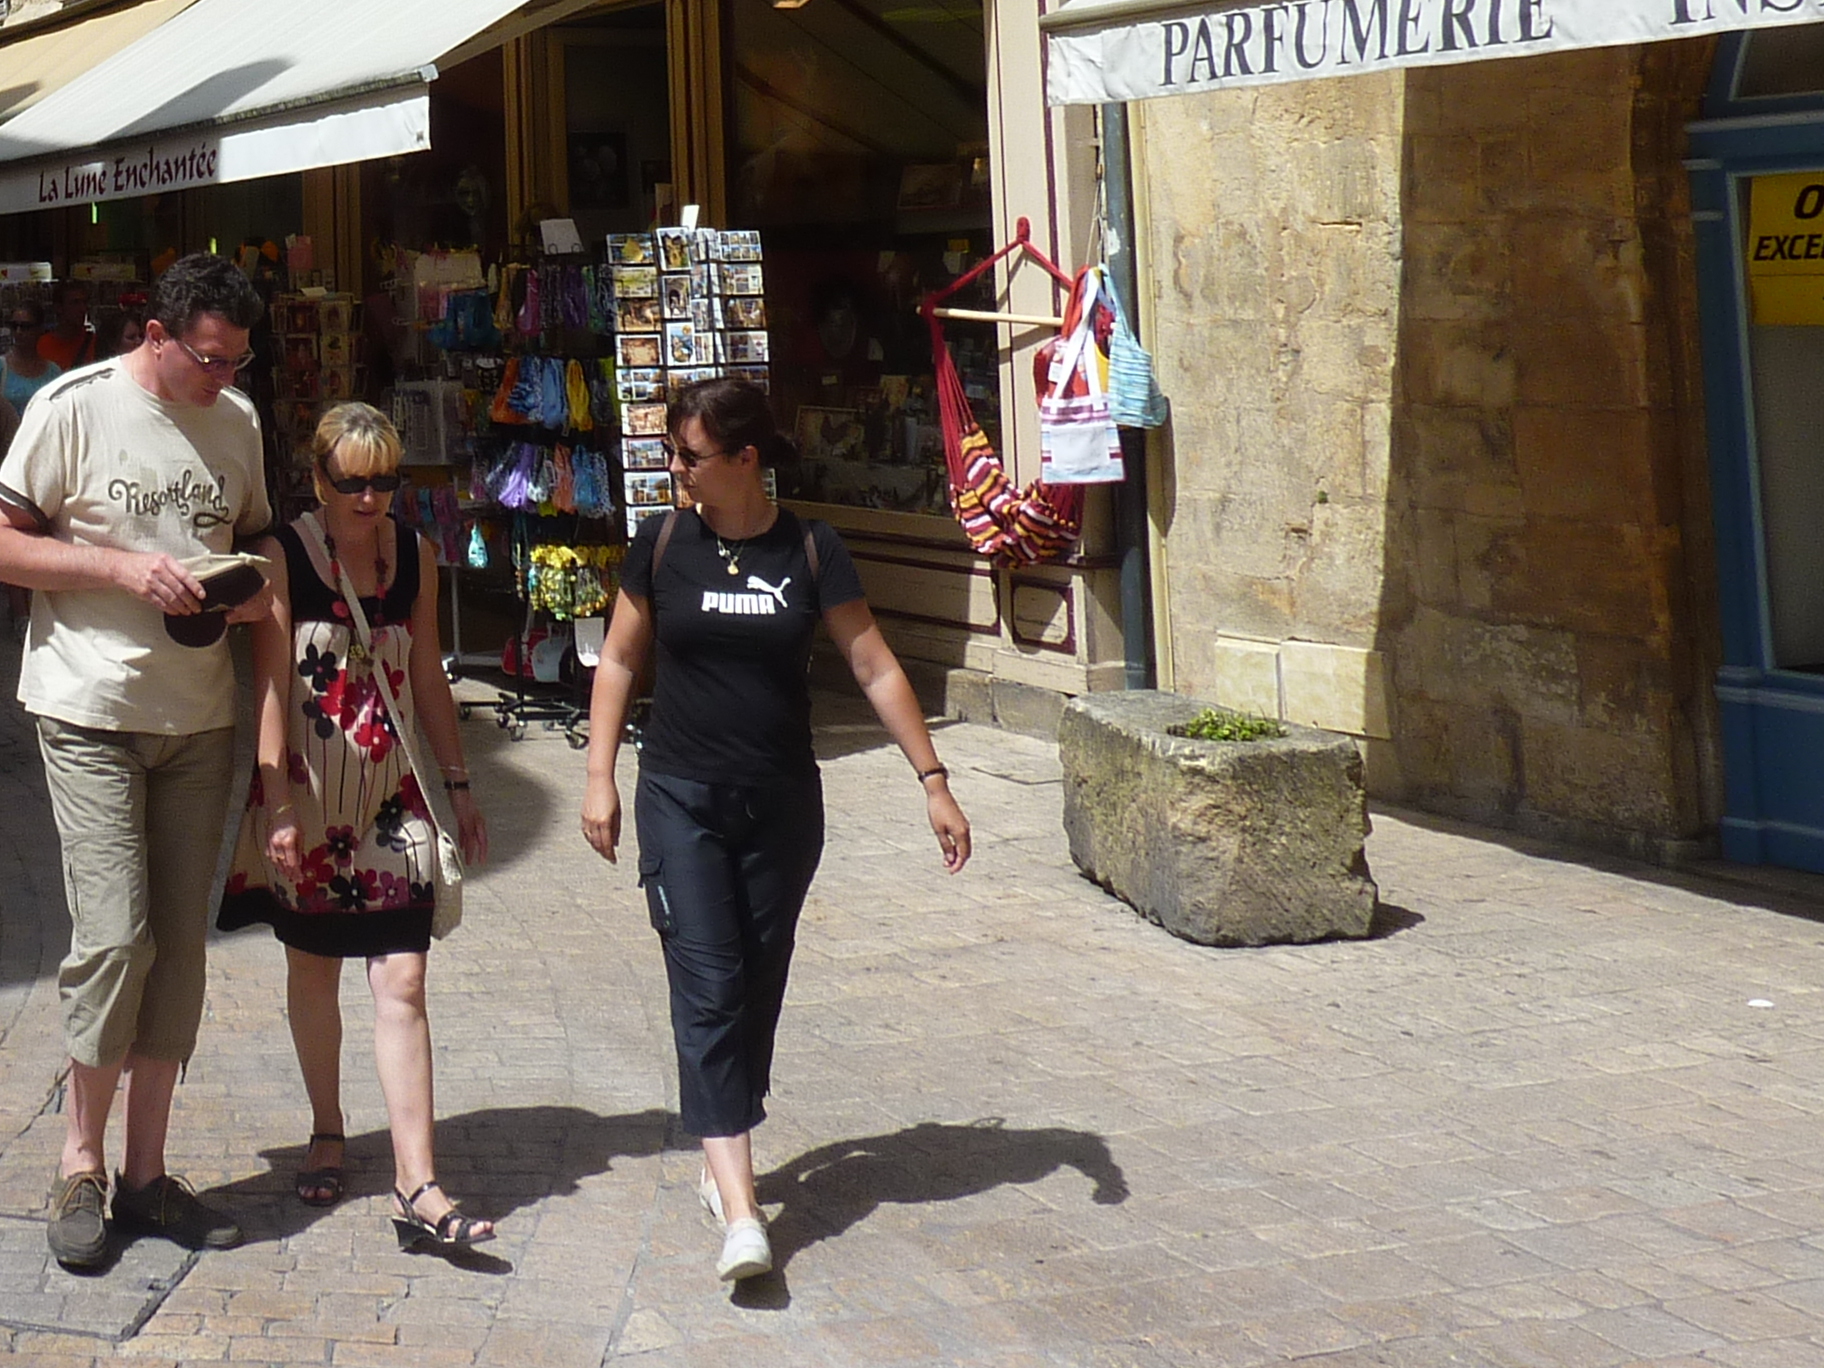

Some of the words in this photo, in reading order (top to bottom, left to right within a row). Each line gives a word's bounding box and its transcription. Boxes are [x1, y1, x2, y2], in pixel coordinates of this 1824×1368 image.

[39, 170, 58, 203] La
[65, 165, 107, 200] Lune
[113, 142, 217, 192] Enchantée
[701, 591, 776, 614] PUMA
